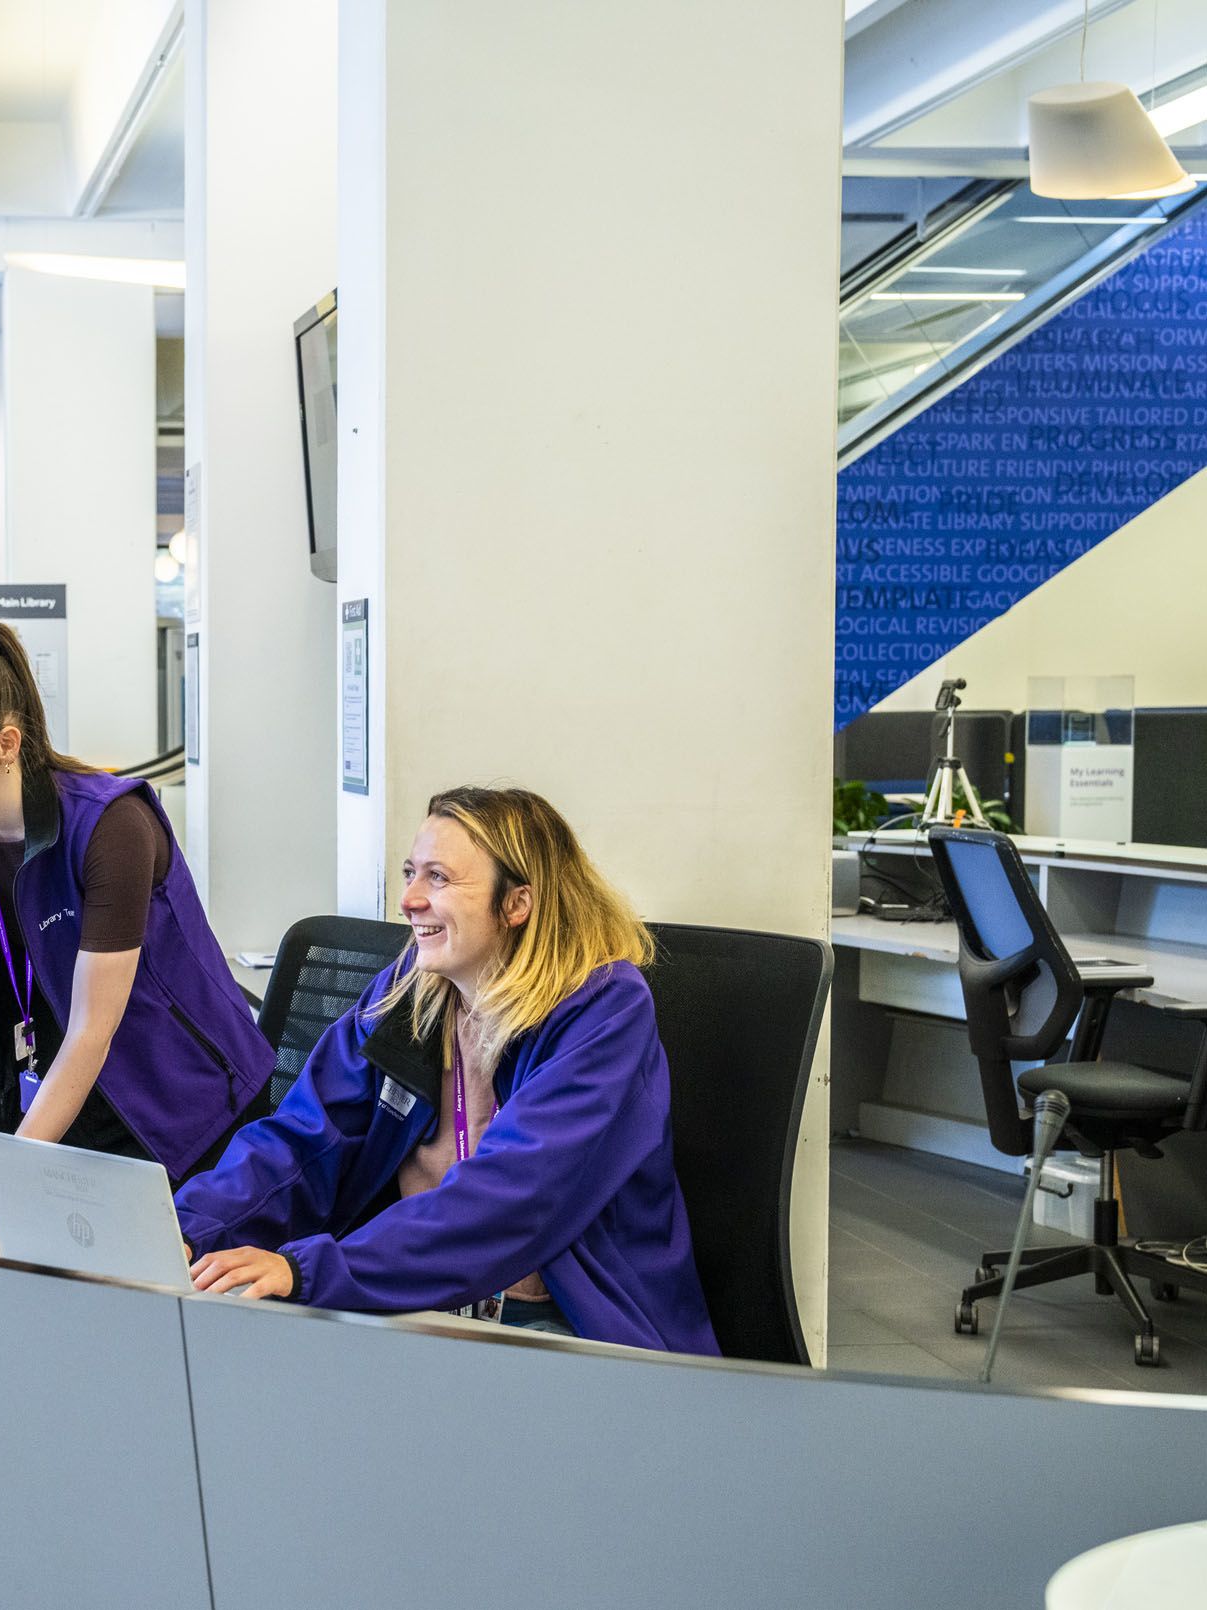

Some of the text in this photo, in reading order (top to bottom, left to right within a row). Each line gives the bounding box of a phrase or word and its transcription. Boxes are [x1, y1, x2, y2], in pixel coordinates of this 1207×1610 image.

[1132, 275, 1207, 292] SUPPOR
[1057, 301, 1115, 319] OCIAL
[1186, 302, 1207, 320] LO
[986, 354, 1207, 372] MPUTERS MISSION ASS
[954, 380, 1018, 398] EARCH
[1158, 381, 1207, 399] CLAR
[972, 406, 1091, 424] RESPONSIVE
[1095, 406, 1188, 424] TAILORED
[935, 432, 997, 450] SPARK
[903, 458, 990, 476] CULTURE
[995, 459, 1087, 477] FRIENDLY
[1092, 459, 1204, 477] PHILOSOPH
[937, 511, 1015, 530] LIBRARY
[1020, 511, 1136, 530] SUPPORTIV
[860, 563, 973, 582] ACCESSIBLE
[20, 596, 57, 610] Library
[916, 616, 994, 635] REVISIO
[1070, 768, 1125, 777] My Learning
[1070, 779, 1113, 788] Essentials
[38, 911, 62, 931] Library
